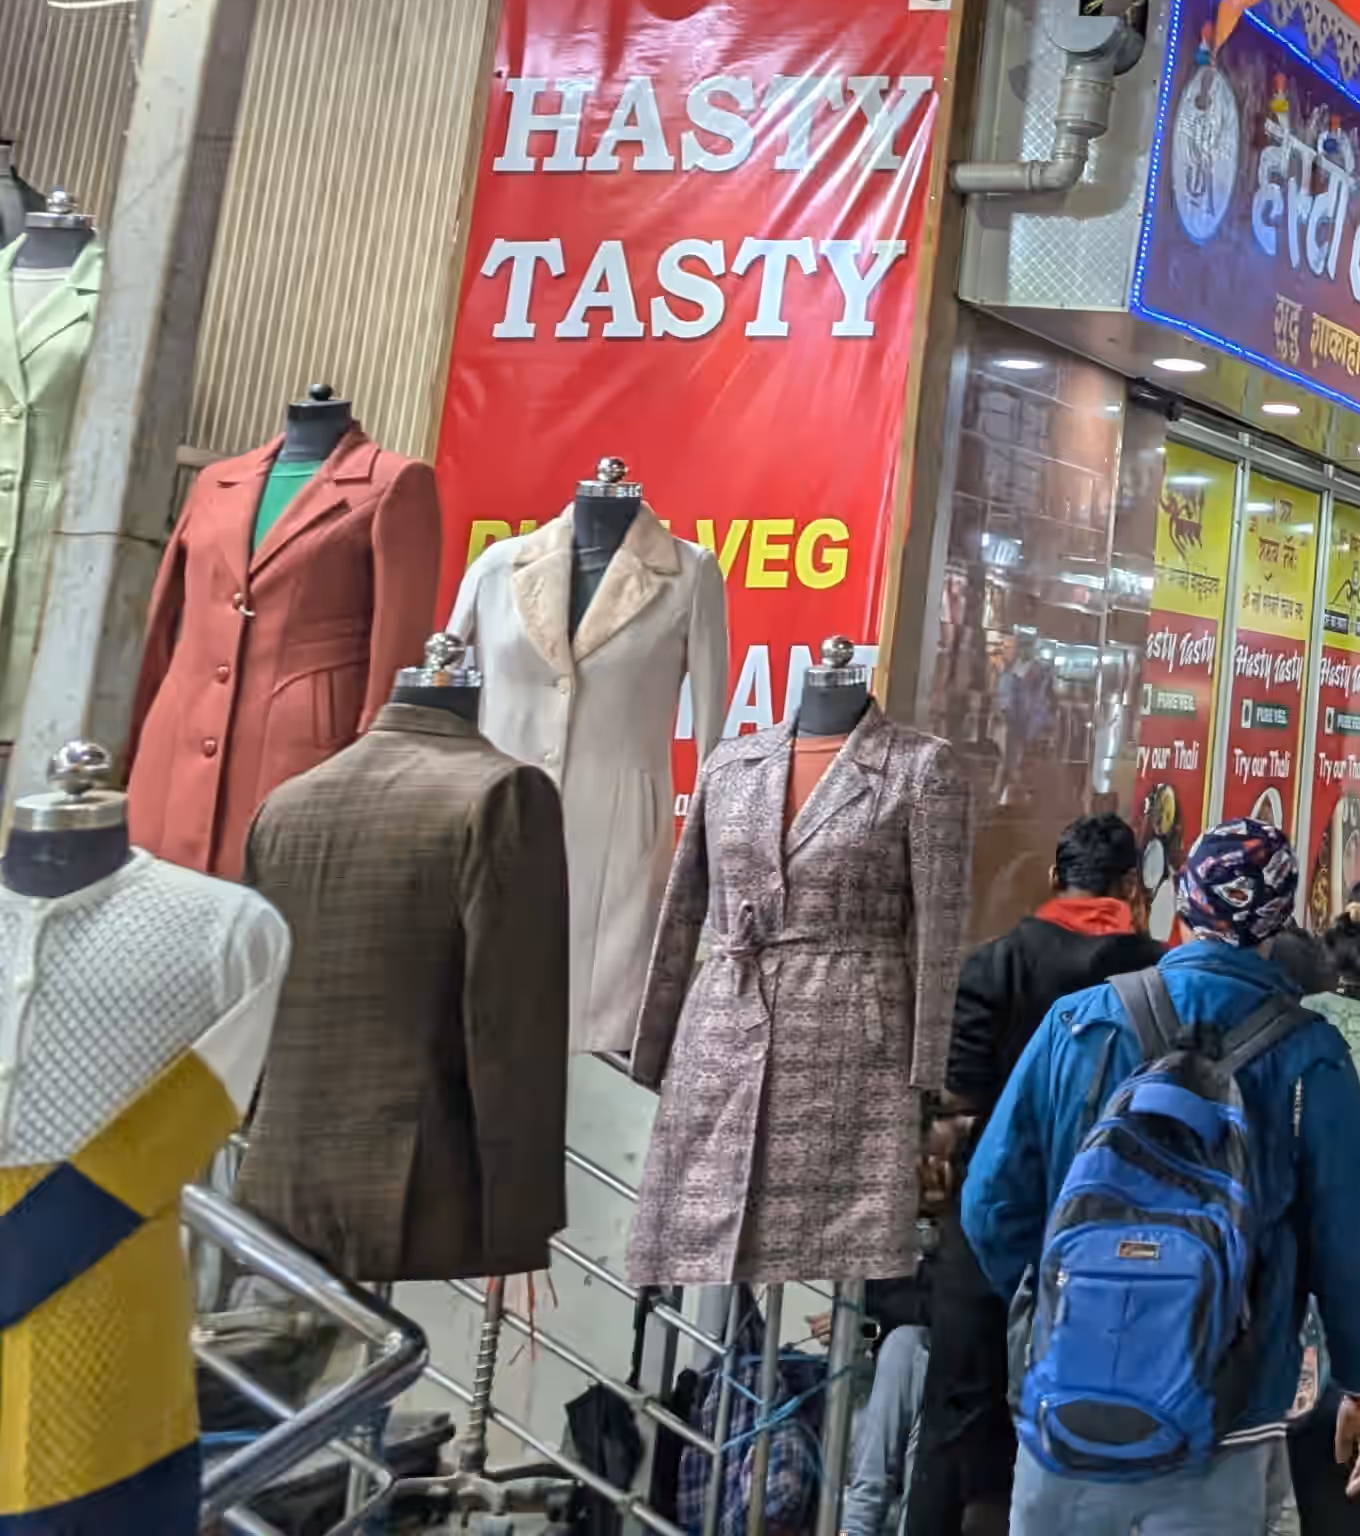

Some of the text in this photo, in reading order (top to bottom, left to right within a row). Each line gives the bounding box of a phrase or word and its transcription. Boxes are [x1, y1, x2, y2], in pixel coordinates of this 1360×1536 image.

[493, 75, 932, 172] HASTY
[481, 238, 906, 338] TASTY
[696, 519, 850, 589] VEG
[1174, 740, 1200, 770] Thali
[1234, 748, 1251, 784] Try
[1269, 750, 1292, 778] Thali
[1319, 752, 1332, 785] Try
